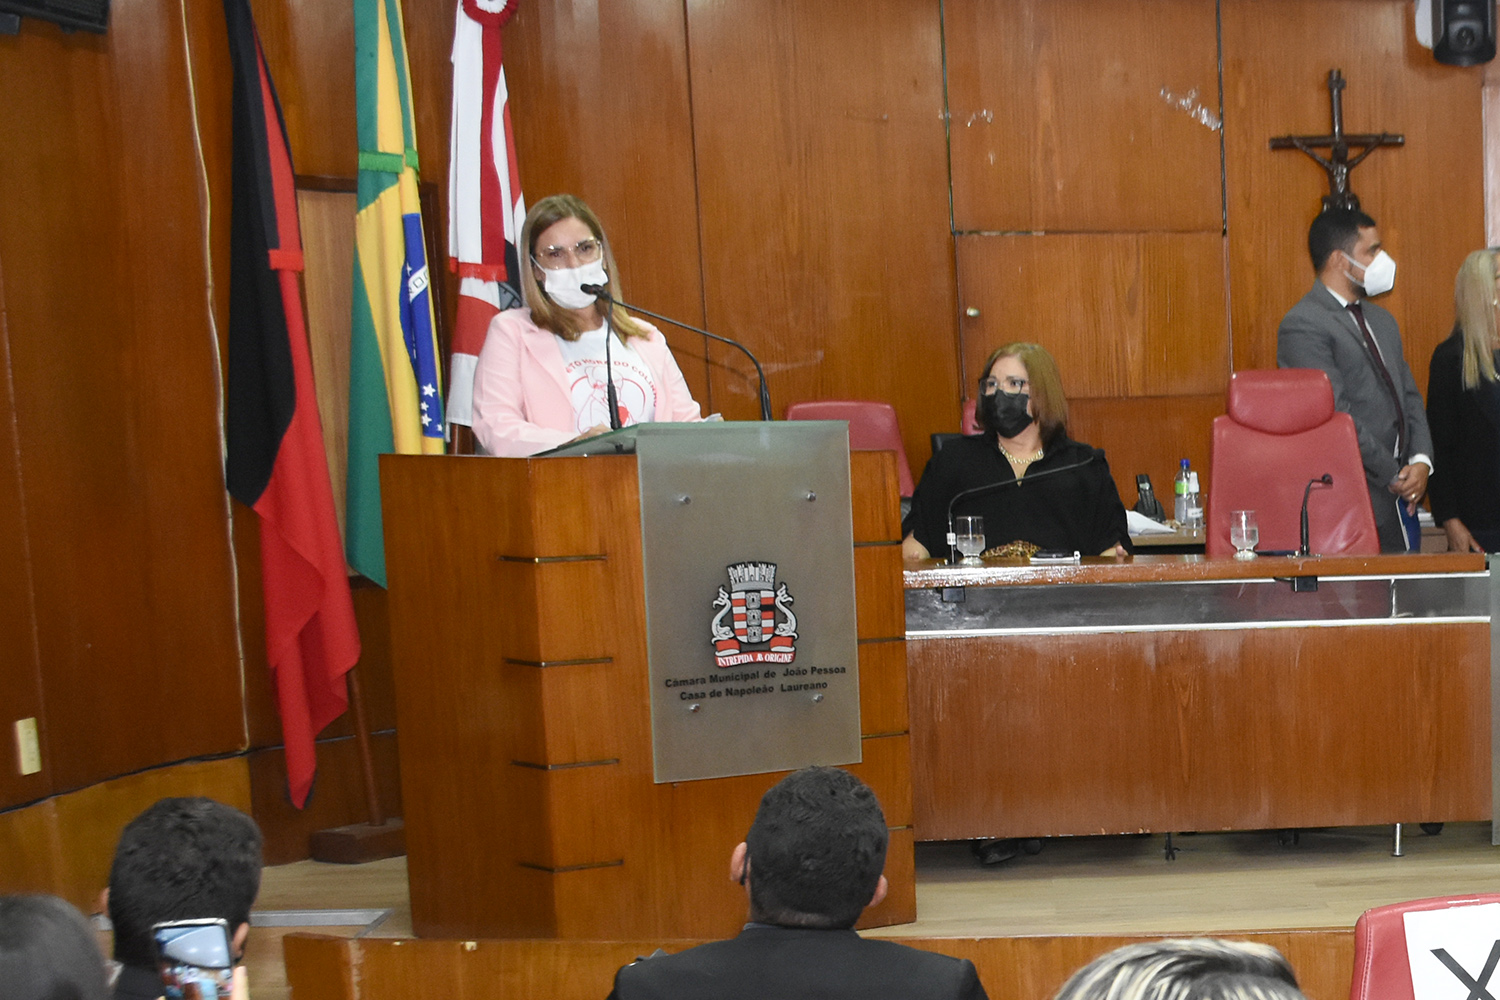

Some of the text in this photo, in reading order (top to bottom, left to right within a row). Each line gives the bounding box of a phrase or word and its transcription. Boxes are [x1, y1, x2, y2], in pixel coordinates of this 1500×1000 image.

[717, 653, 754, 667] INTREPIDA
[765, 653, 794, 663] ORIGINE
[665, 666, 846, 688] Câmara Municipal de João Pessoa
[680, 681, 828, 701] Casa de Napoleão Laureano
